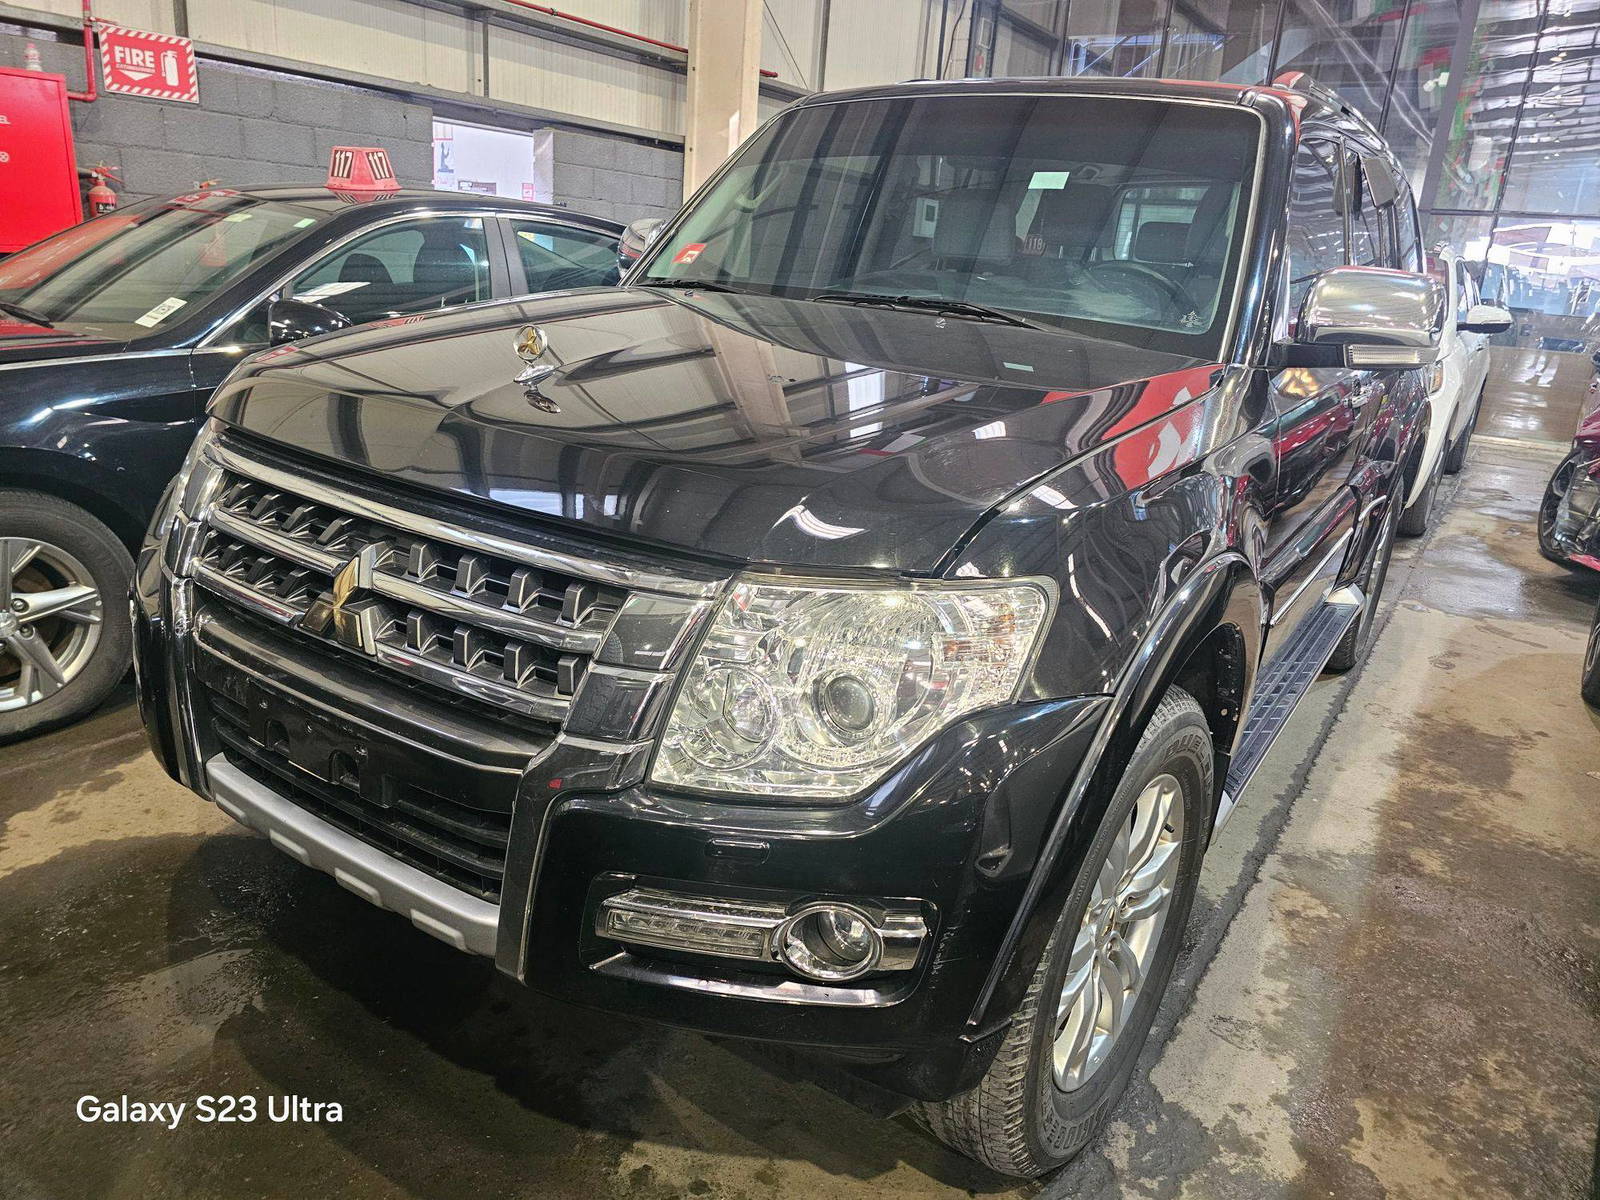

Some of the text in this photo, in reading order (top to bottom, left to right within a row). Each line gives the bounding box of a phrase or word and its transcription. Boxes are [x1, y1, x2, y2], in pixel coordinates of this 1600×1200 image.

[114, 45, 155, 68] FIRE
[334, 151, 353, 178] 117
[368, 152, 390, 179] 117
